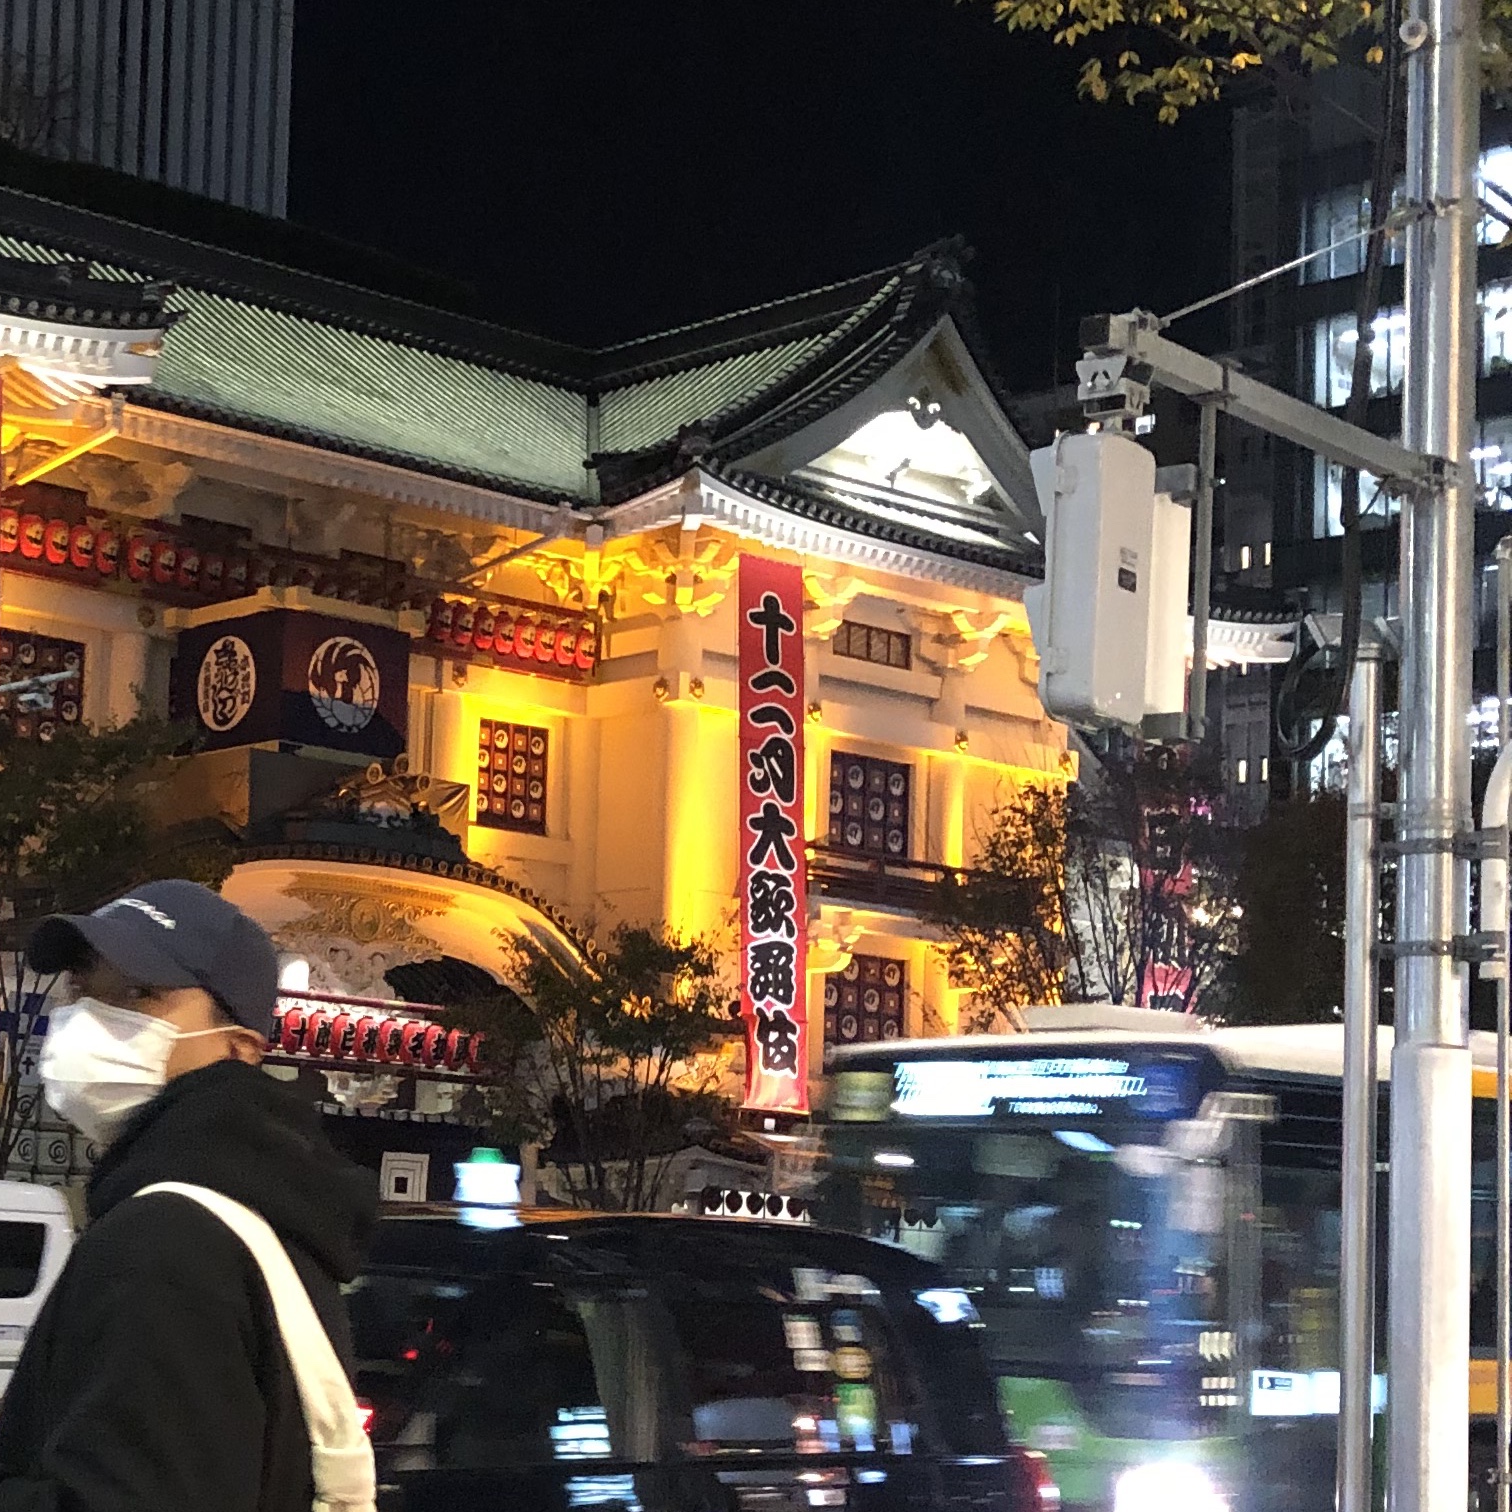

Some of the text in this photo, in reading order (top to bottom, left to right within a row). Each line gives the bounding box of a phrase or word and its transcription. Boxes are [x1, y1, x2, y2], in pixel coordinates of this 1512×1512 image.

[747, 593, 800, 1078] 十二月大歌舞伎
